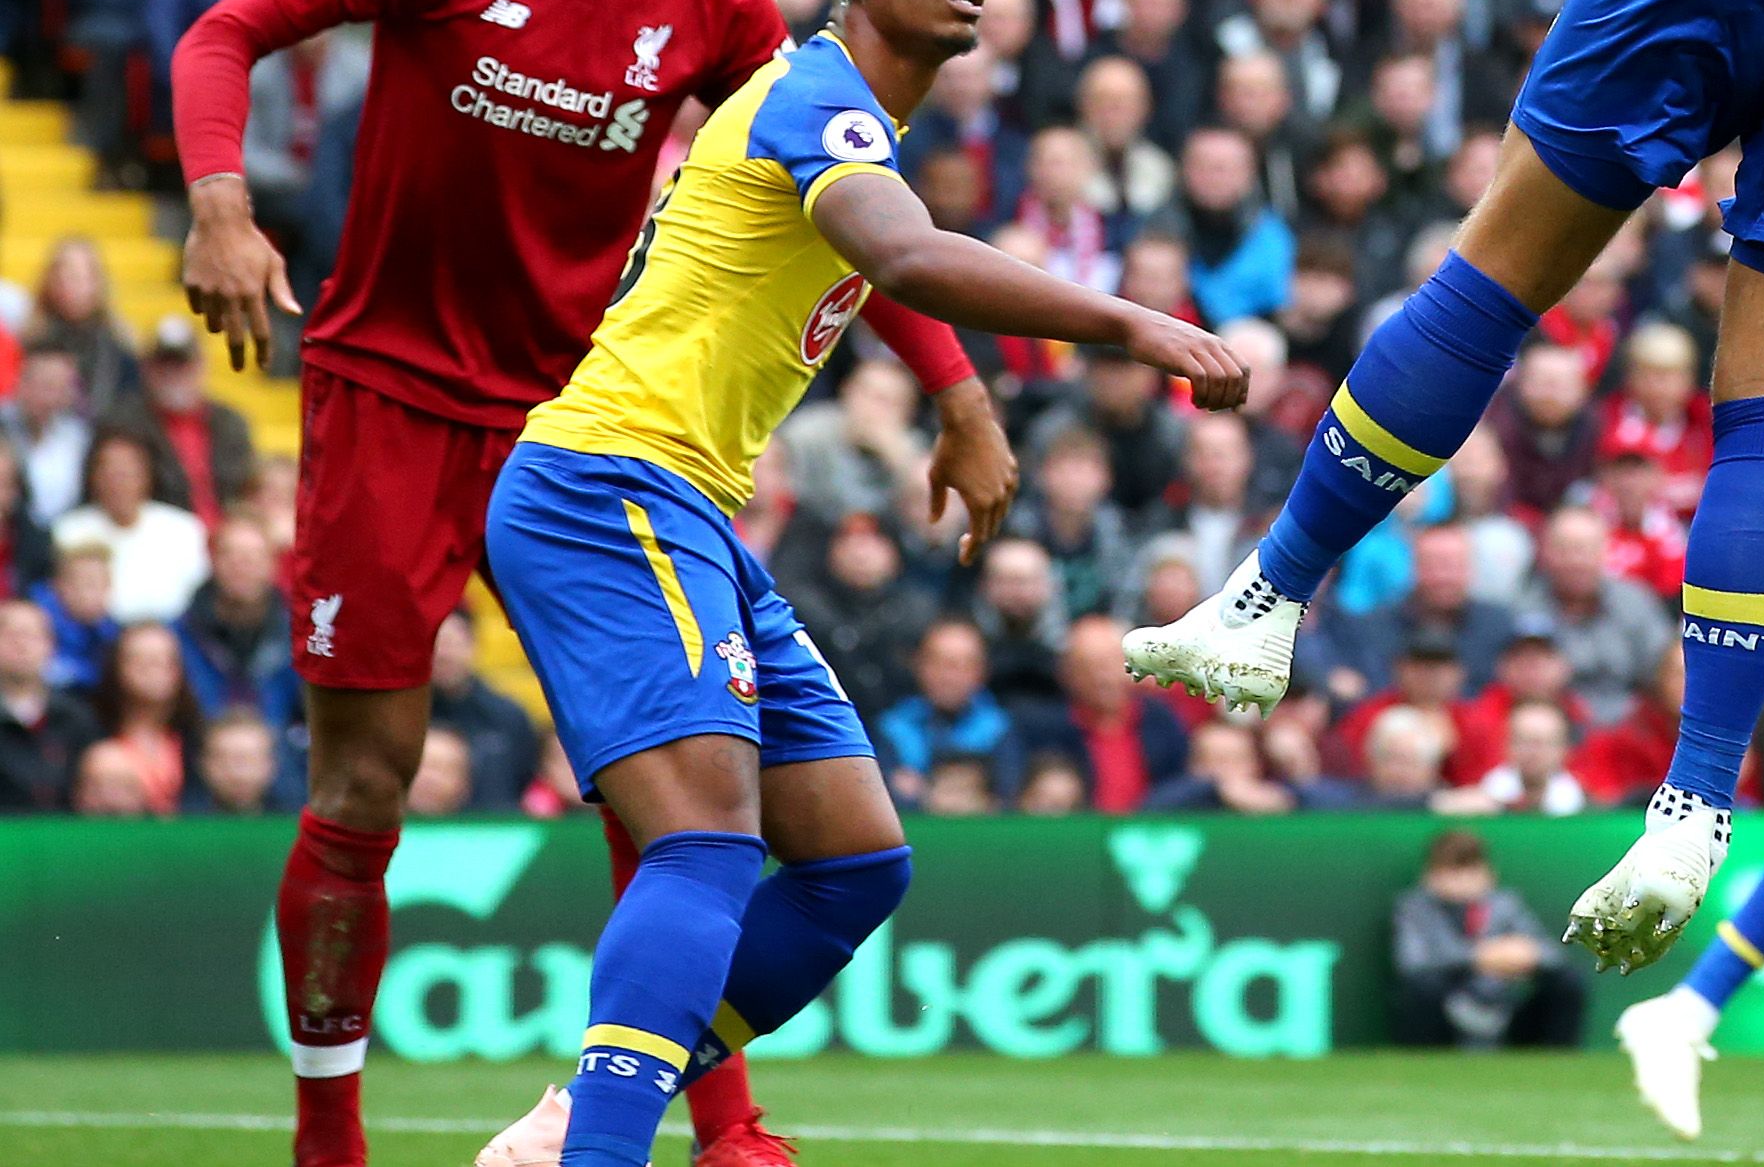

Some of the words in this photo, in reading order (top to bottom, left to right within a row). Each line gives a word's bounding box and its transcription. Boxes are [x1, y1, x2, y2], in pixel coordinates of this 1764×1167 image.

[450, 84, 602, 147] Chartered
[472, 56, 614, 120] Standard
[257, 823, 1340, 1059] Caberg
[576, 1052, 642, 1077] TS
